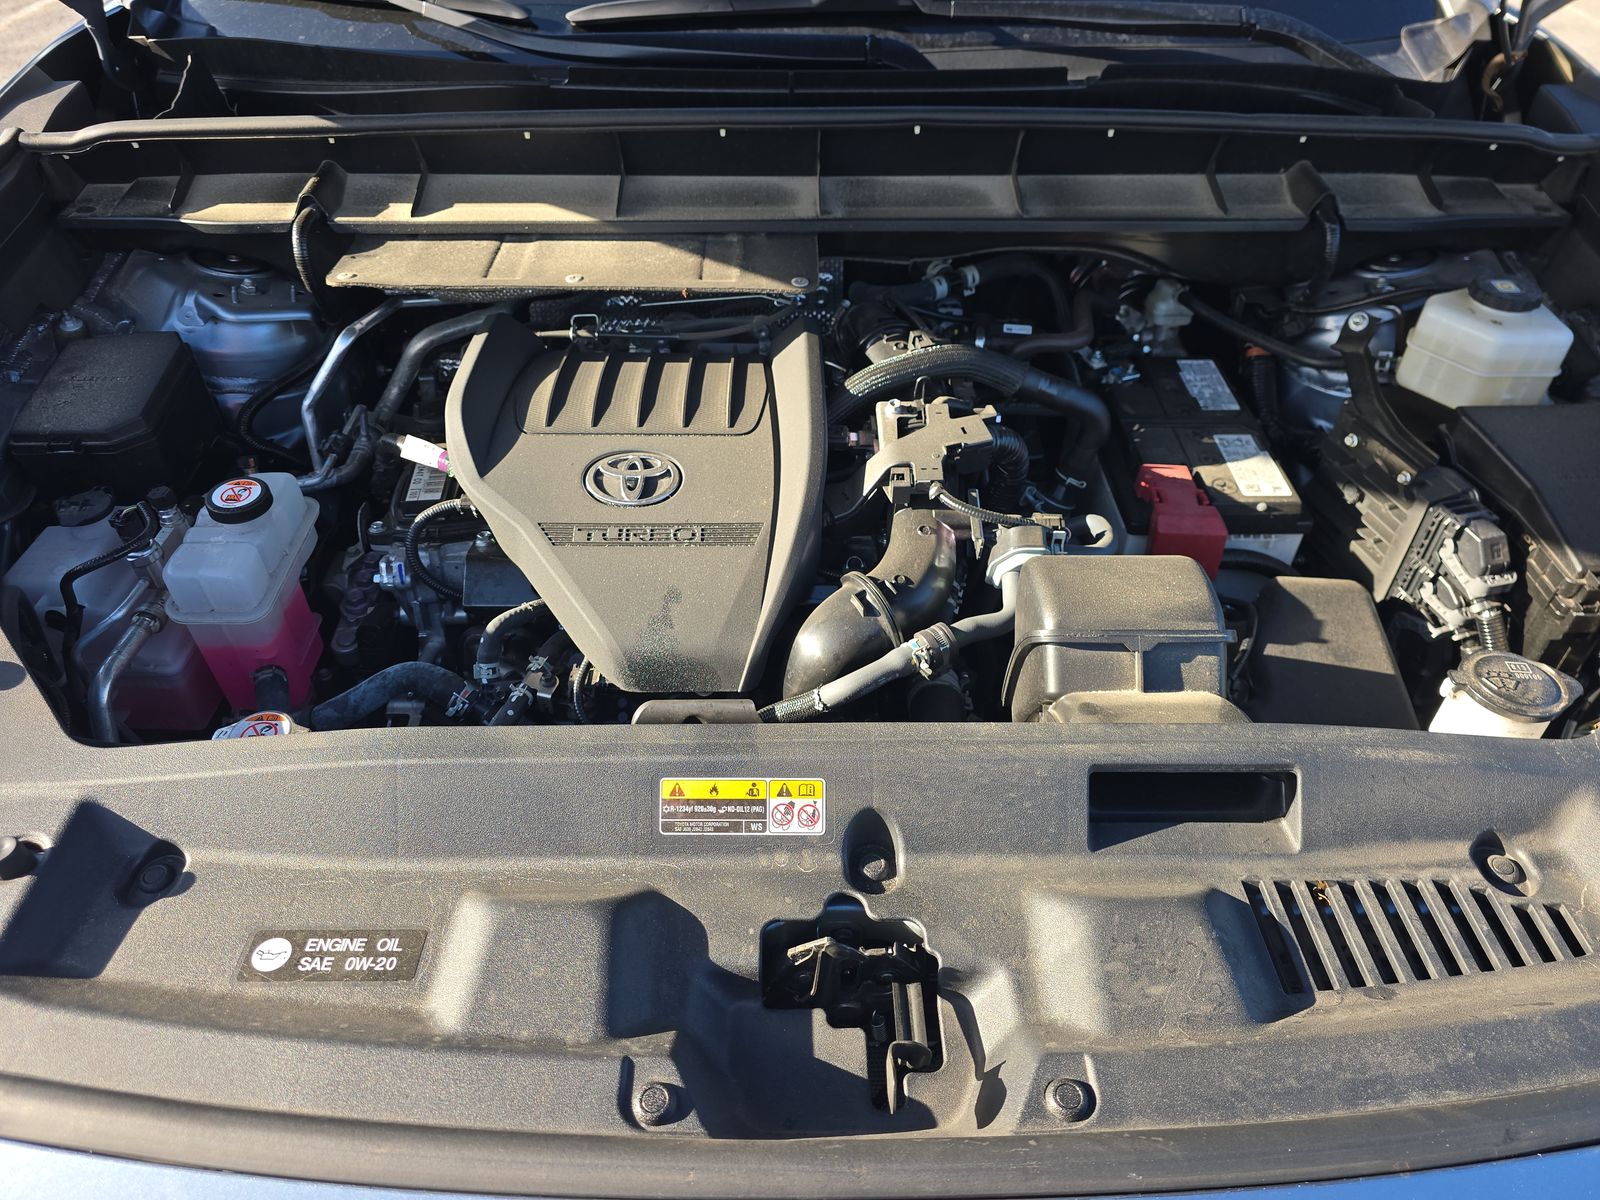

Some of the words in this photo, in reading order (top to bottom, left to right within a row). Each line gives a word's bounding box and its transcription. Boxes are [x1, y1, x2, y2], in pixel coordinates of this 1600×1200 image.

[670, 805, 693, 813] R-1234yf
[751, 805, 765, 813] (PAG)
[750, 823, 763, 831] WS
[305, 938, 368, 952] ENGINE
[376, 938, 403, 952] OIL
[297, 956, 335, 972] SAE
[344, 956, 397, 971] 0W-20
